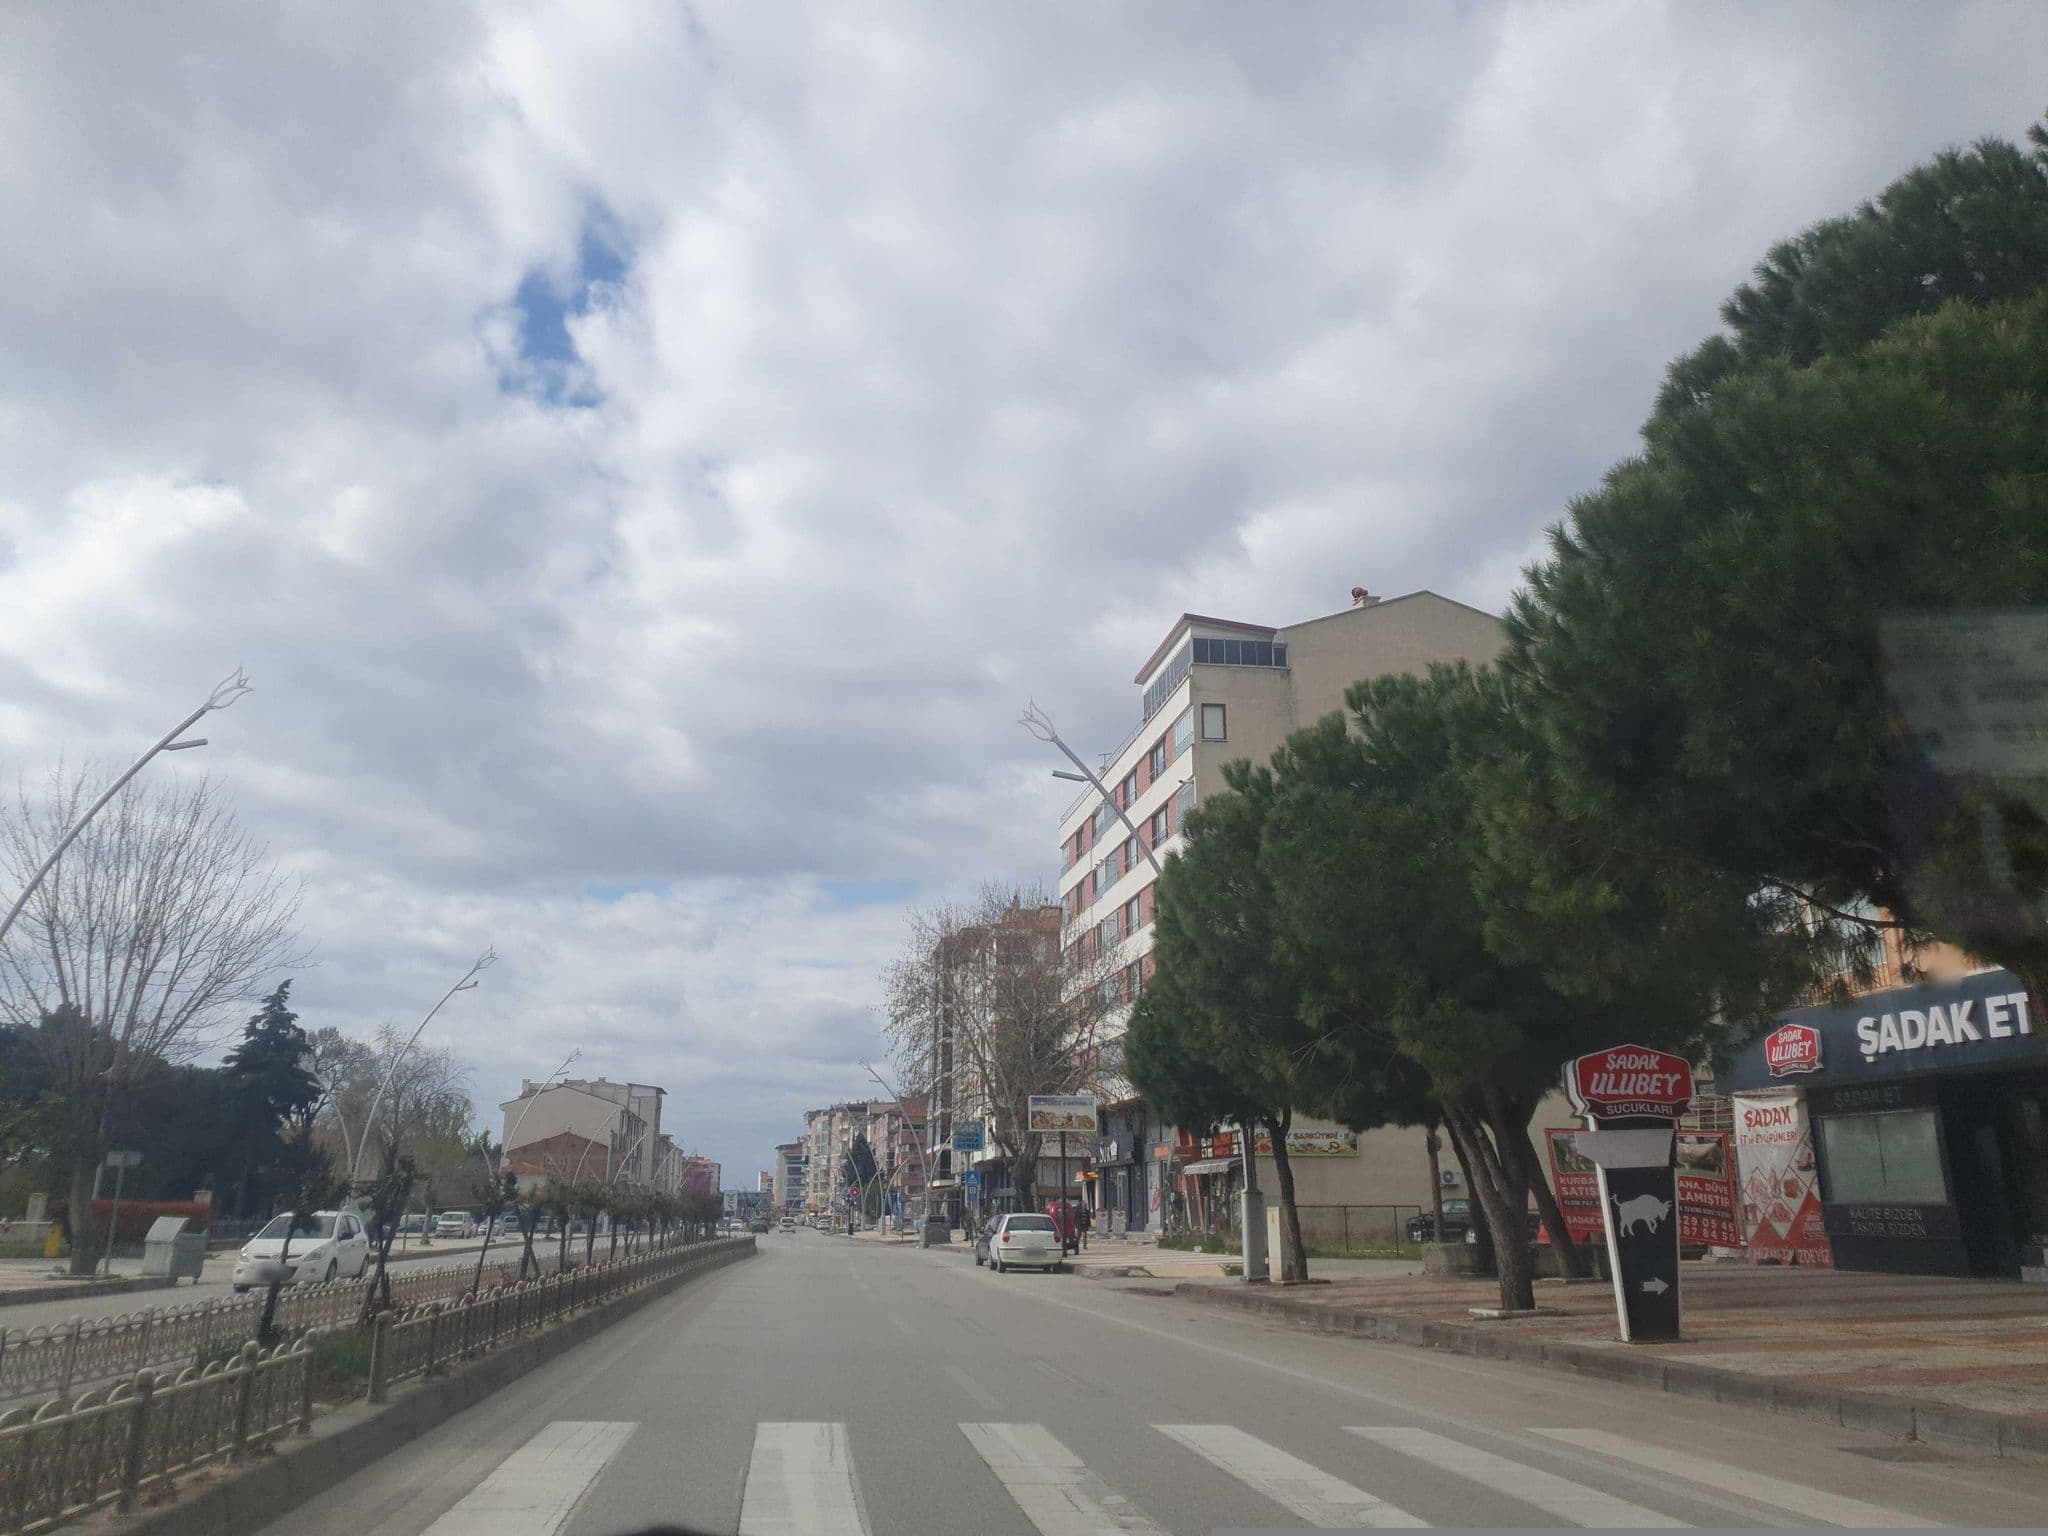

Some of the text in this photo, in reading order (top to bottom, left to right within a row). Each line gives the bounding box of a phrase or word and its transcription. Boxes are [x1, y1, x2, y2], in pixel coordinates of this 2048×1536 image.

[1857, 992, 2031, 1062] ŞADAK ET
[1606, 1053, 1660, 1071] ŞADAK
[1771, 1040, 1811, 1062] ULUBEY
[1590, 1073, 1681, 1095] ULUBEY
[1606, 1103, 1674, 1115] SUCUKLARI
[1744, 1105, 1792, 1132] ŞADAK
